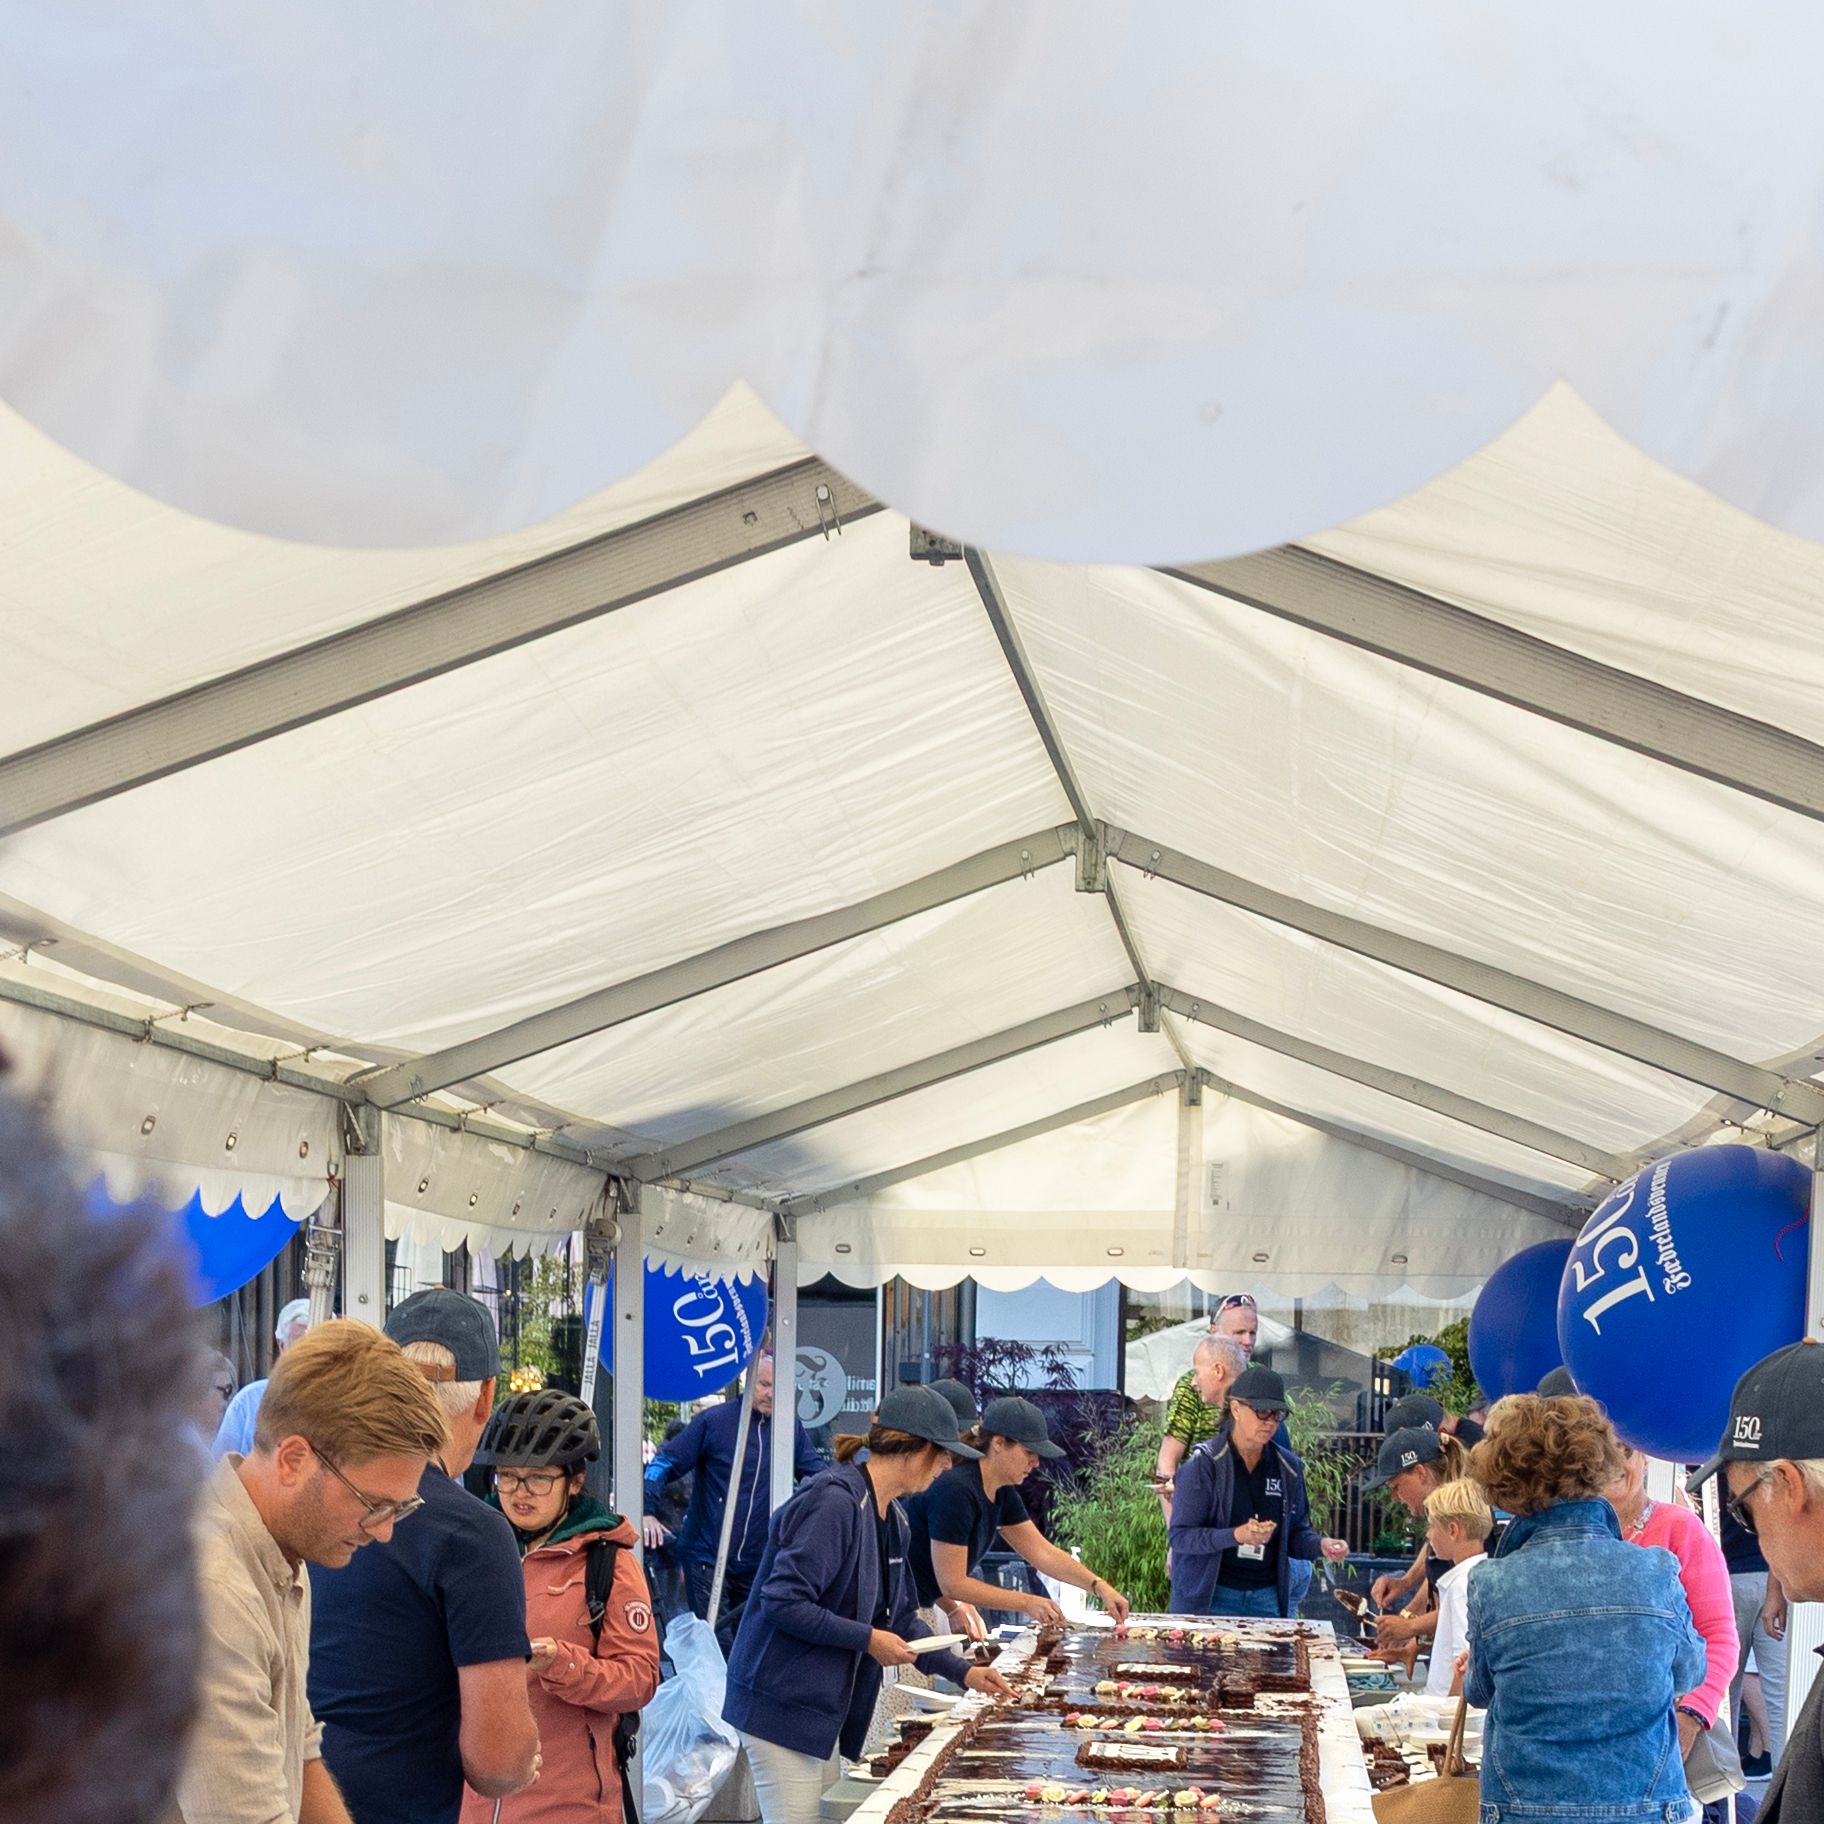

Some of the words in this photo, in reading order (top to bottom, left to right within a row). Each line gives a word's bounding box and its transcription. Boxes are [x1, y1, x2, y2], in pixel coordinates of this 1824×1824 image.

[589, 1319, 601, 1350] JALLA
[673, 1292, 739, 1379] 150
[1733, 1416, 1760, 1440] 150
[1401, 1450, 1417, 1465] 150
